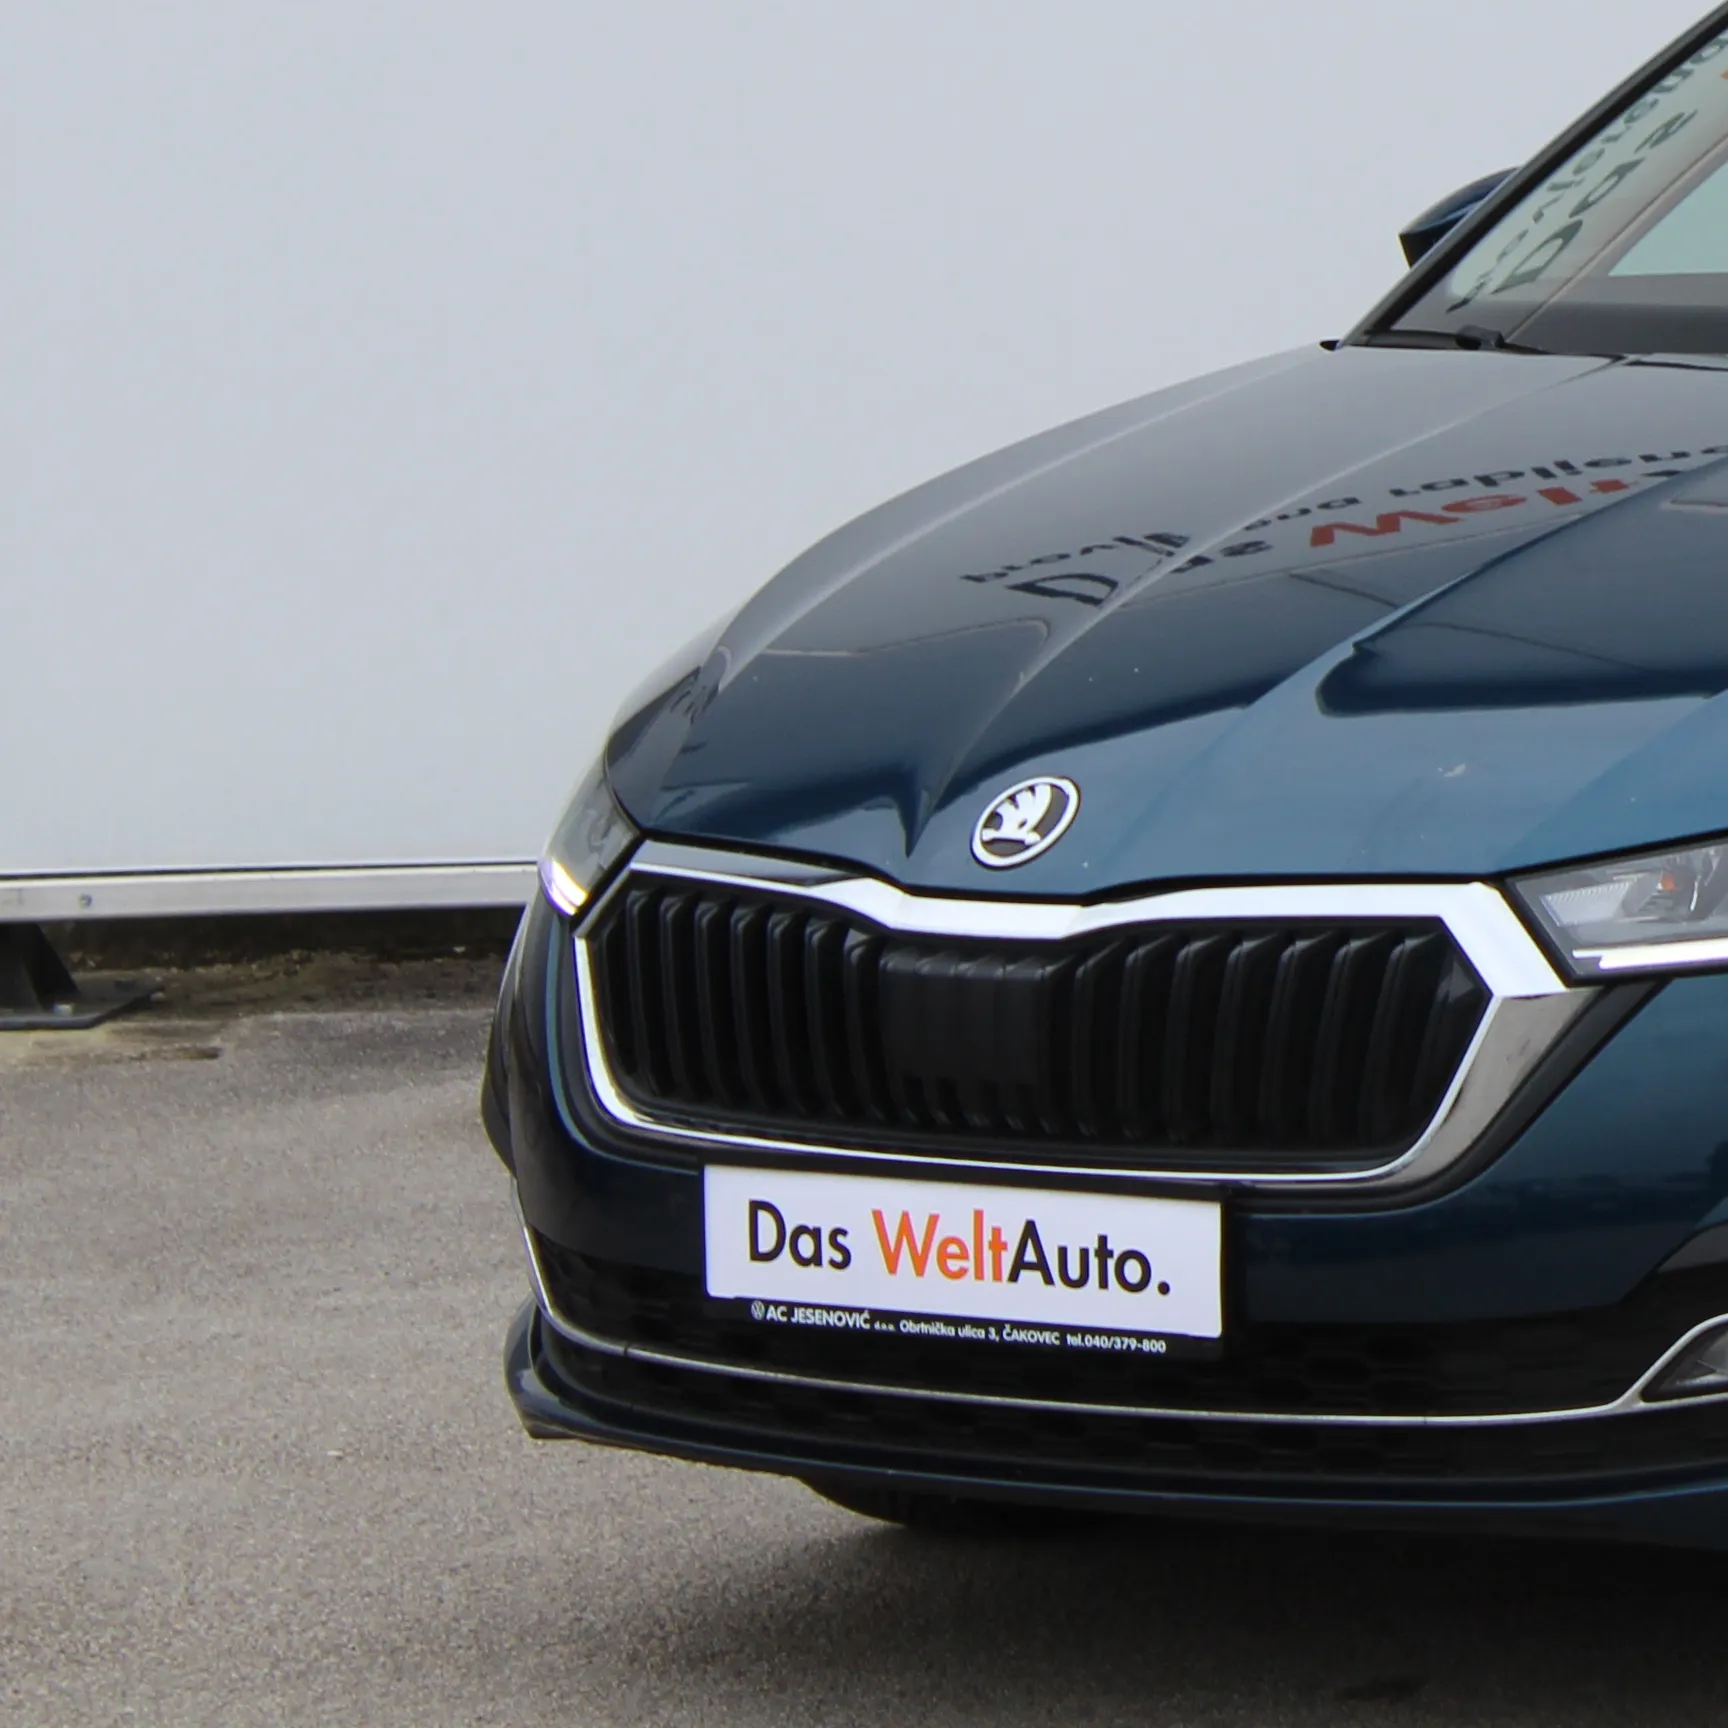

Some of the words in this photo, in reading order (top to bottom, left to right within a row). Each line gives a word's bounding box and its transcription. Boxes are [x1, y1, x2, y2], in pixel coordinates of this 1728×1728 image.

[748, 1198, 852, 1271] Das
[870, 1208, 1171, 1296] WeltAuto.
[766, 1305, 788, 1322] AC
[791, 1308, 871, 1330] JESENOVIĆ
[899, 1319, 956, 1337] Obrtnička
[957, 1324, 986, 1340] ulica
[987, 1327, 1000, 1343] 3,
[1002, 1323, 1061, 1346] ČAKOVEC
